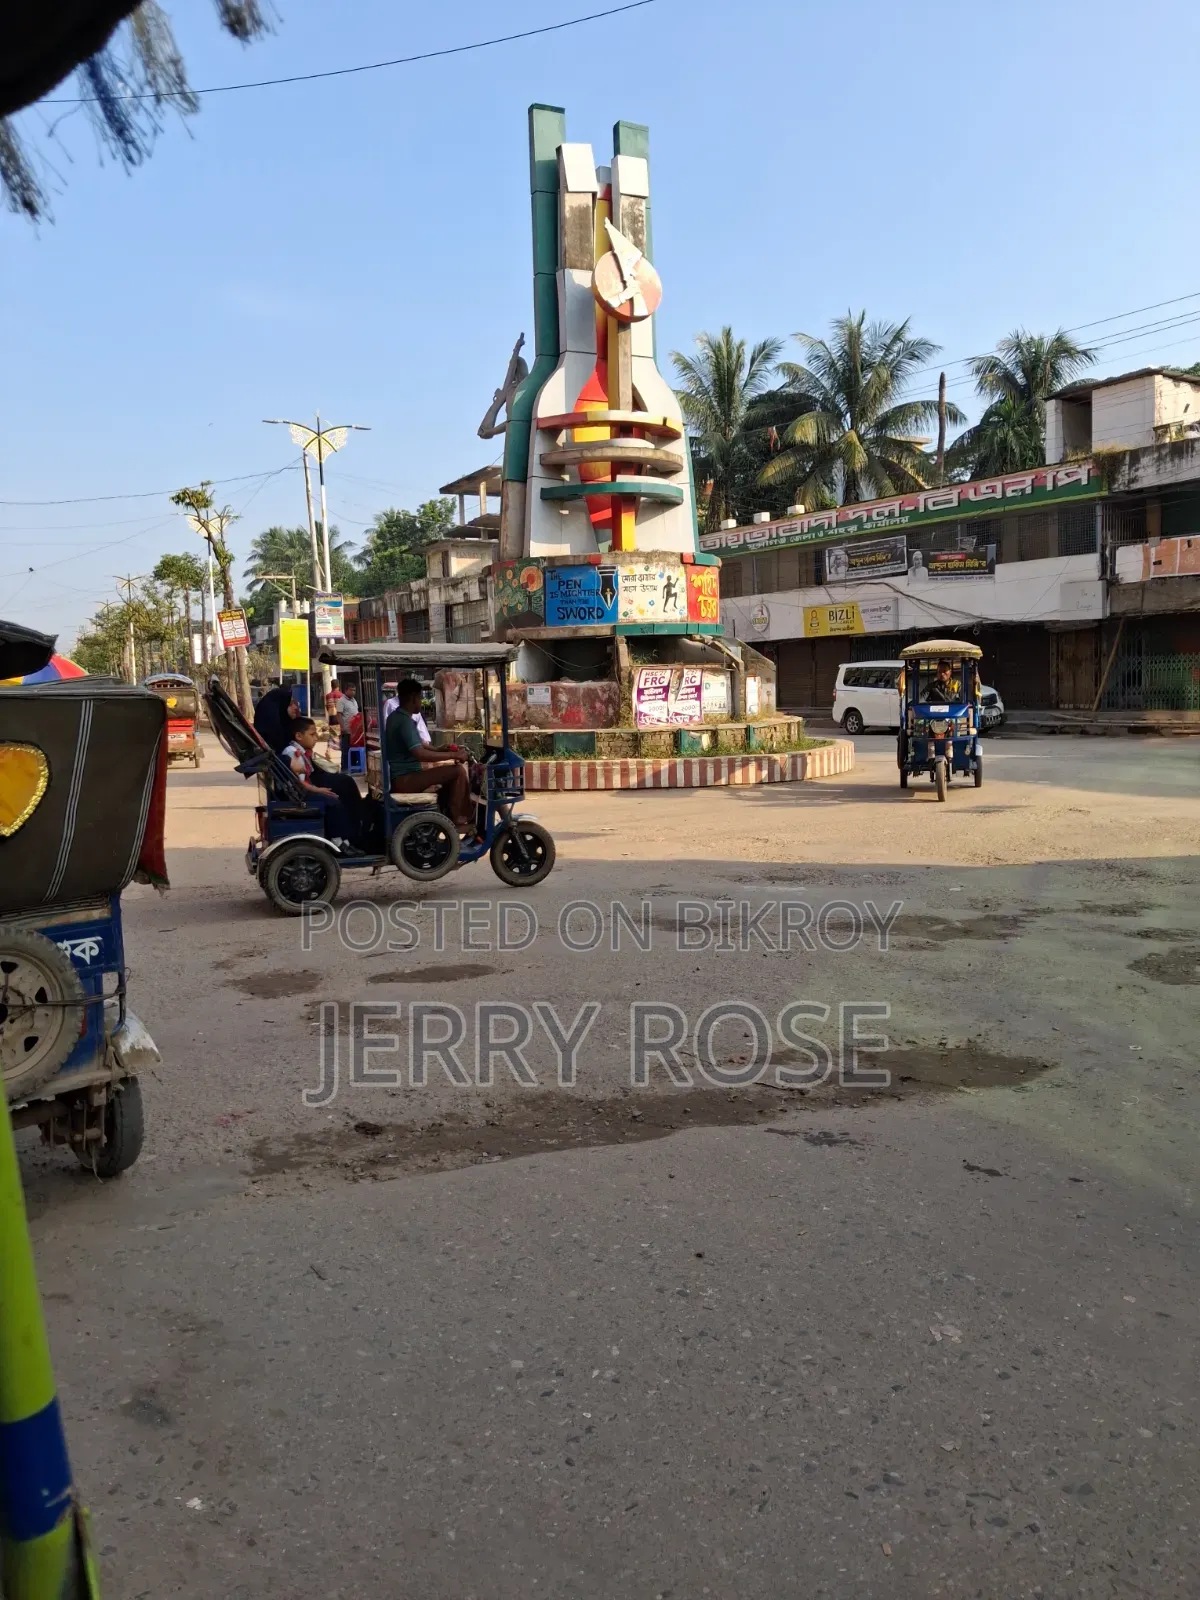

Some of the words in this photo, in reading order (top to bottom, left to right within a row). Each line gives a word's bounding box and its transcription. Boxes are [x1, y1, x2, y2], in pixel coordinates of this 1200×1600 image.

[700, 511, 839, 551] তীয়তাবাদী
[558, 579, 582, 590] PEN
[550, 591, 559, 599] IS
[560, 589, 600, 598] MIGHTIER
[557, 606, 605, 620] SWORD
[644, 676, 666, 687] FRC
[684, 675, 697, 685] RC
